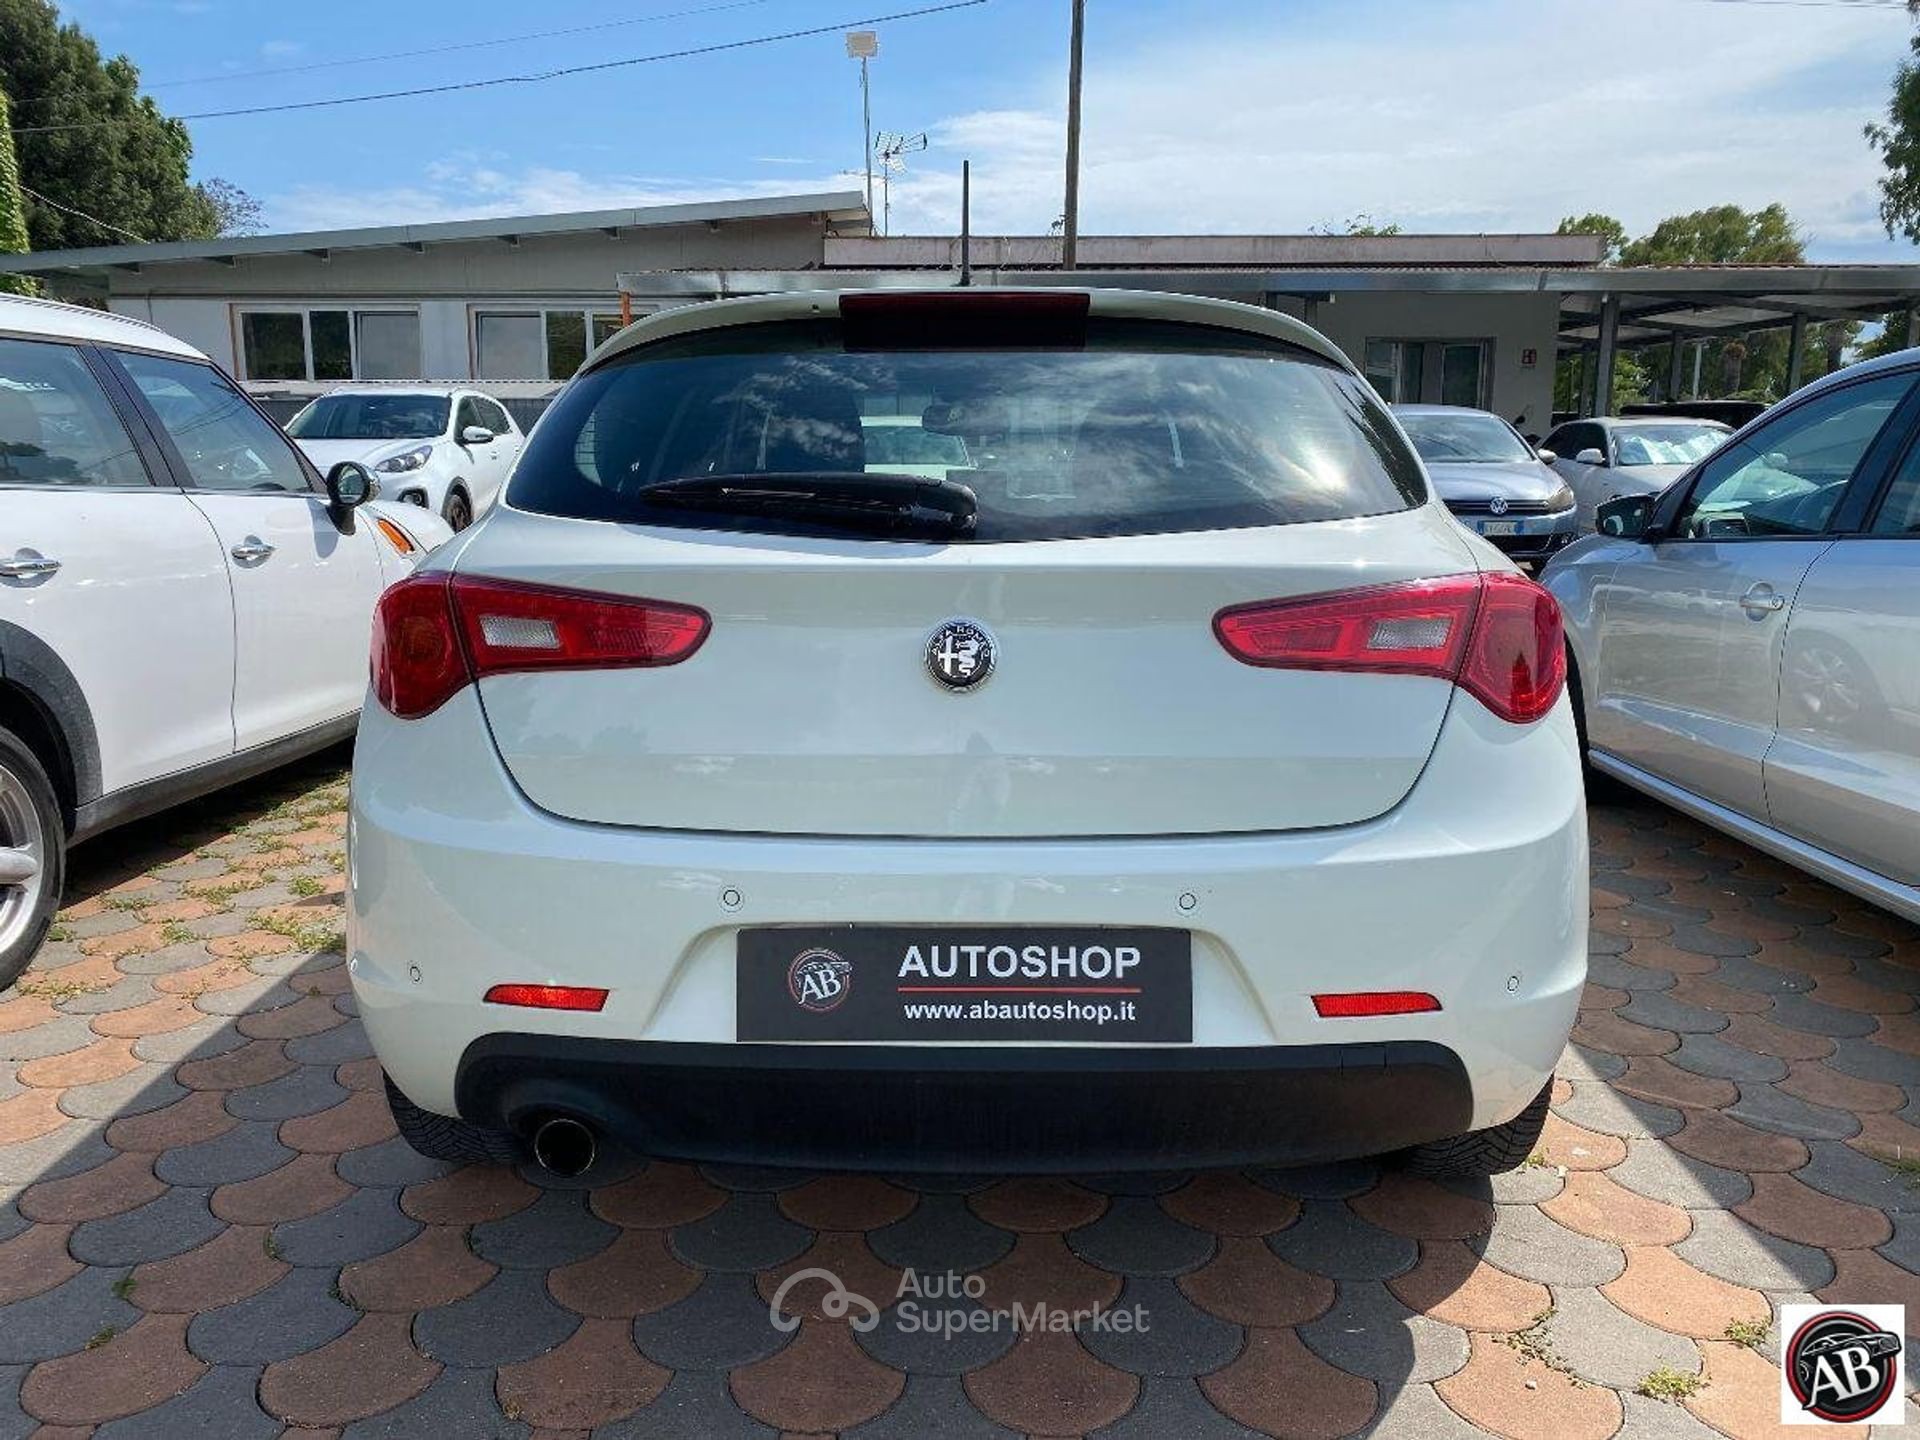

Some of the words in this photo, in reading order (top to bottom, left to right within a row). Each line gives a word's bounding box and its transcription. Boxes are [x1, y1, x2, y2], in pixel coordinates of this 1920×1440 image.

[898, 945, 1141, 978] AUTOSHOP
[799, 969, 841, 1004] AB
[904, 1000, 1136, 1024] www.abautoshop.it
